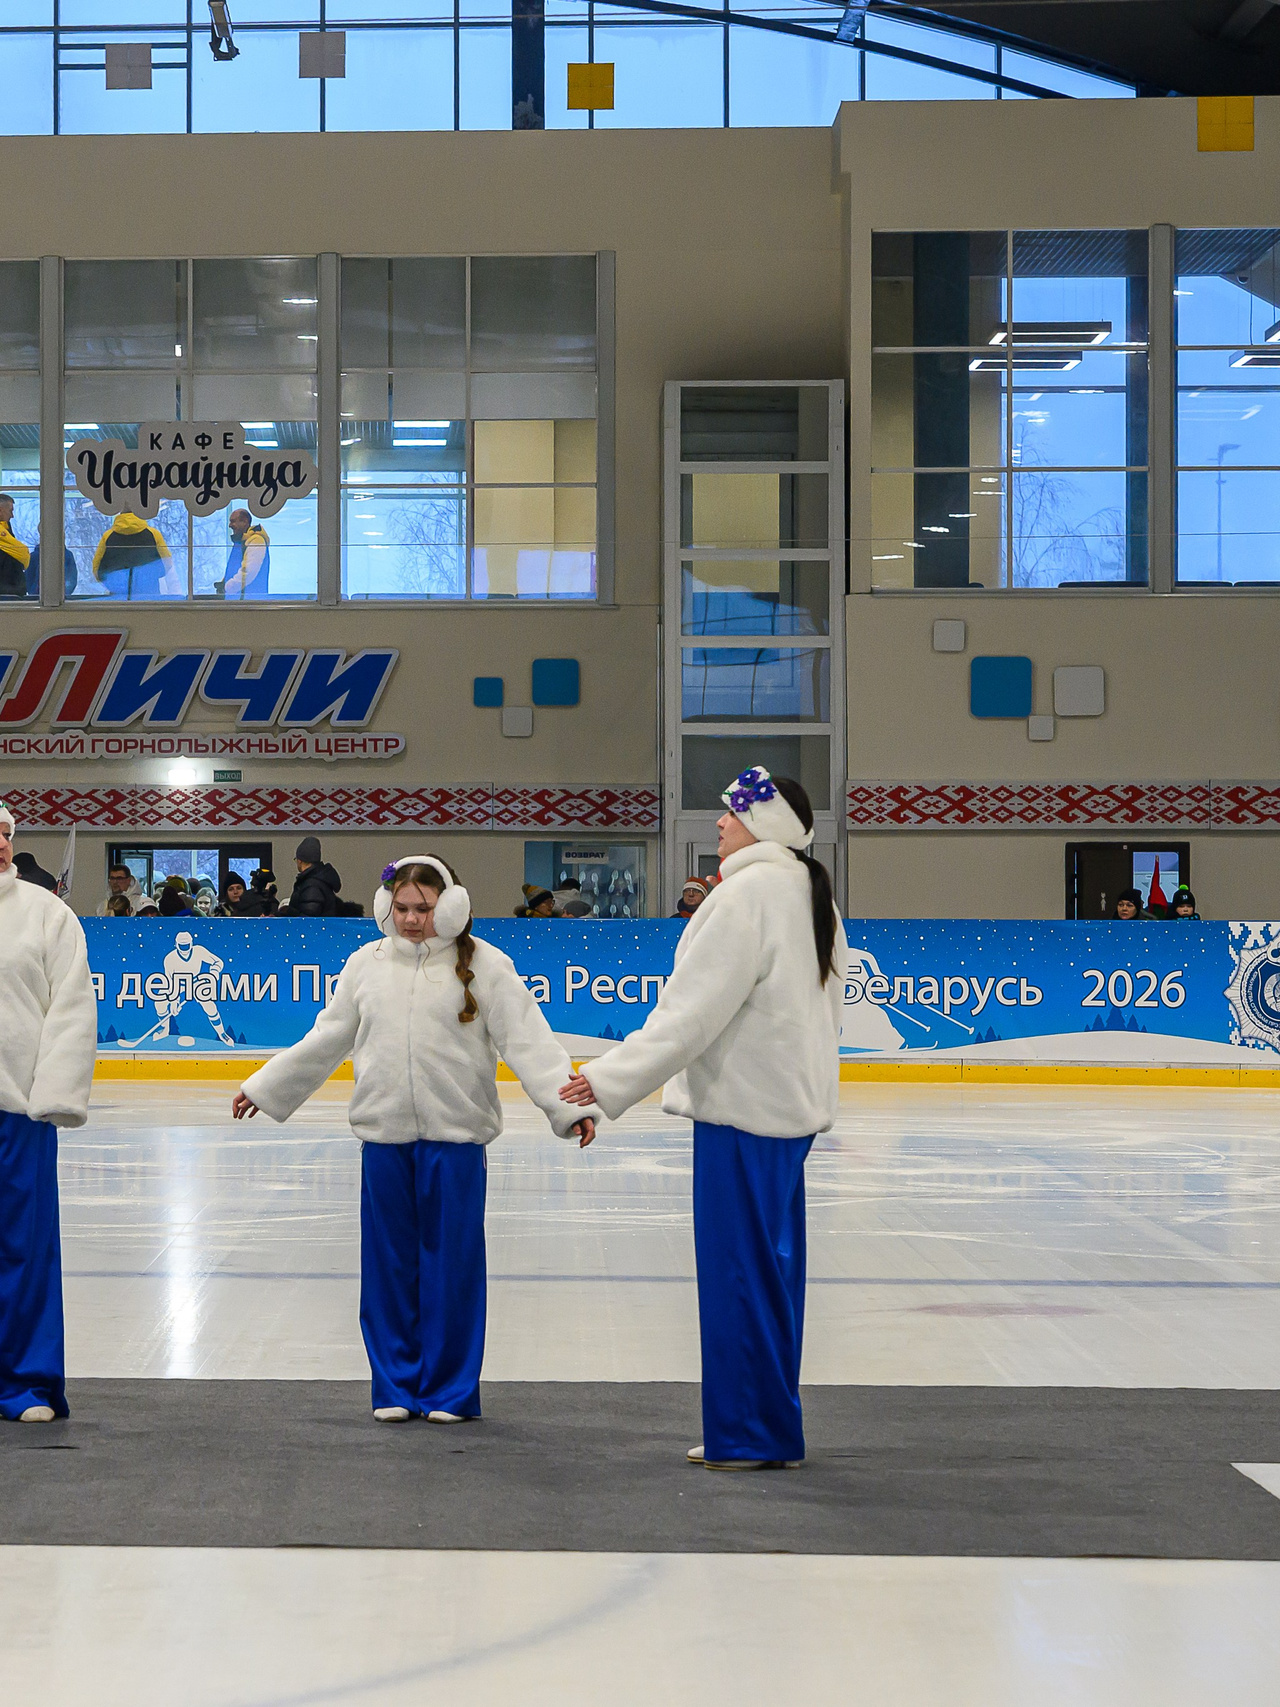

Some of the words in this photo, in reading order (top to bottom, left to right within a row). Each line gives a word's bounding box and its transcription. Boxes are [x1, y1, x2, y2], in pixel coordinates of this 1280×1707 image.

[150, 432, 234, 450] КАФЕ
[77, 449, 308, 508] Чараўніца
[91, 734, 307, 754] ГОРНОЛЫЖНЫЙ
[314, 737, 400, 756] ЦЕНТР
[116, 972, 278, 1008] делами
[843, 965, 1044, 1016] Беларусь
[1081, 969, 1187, 1008] 2026
